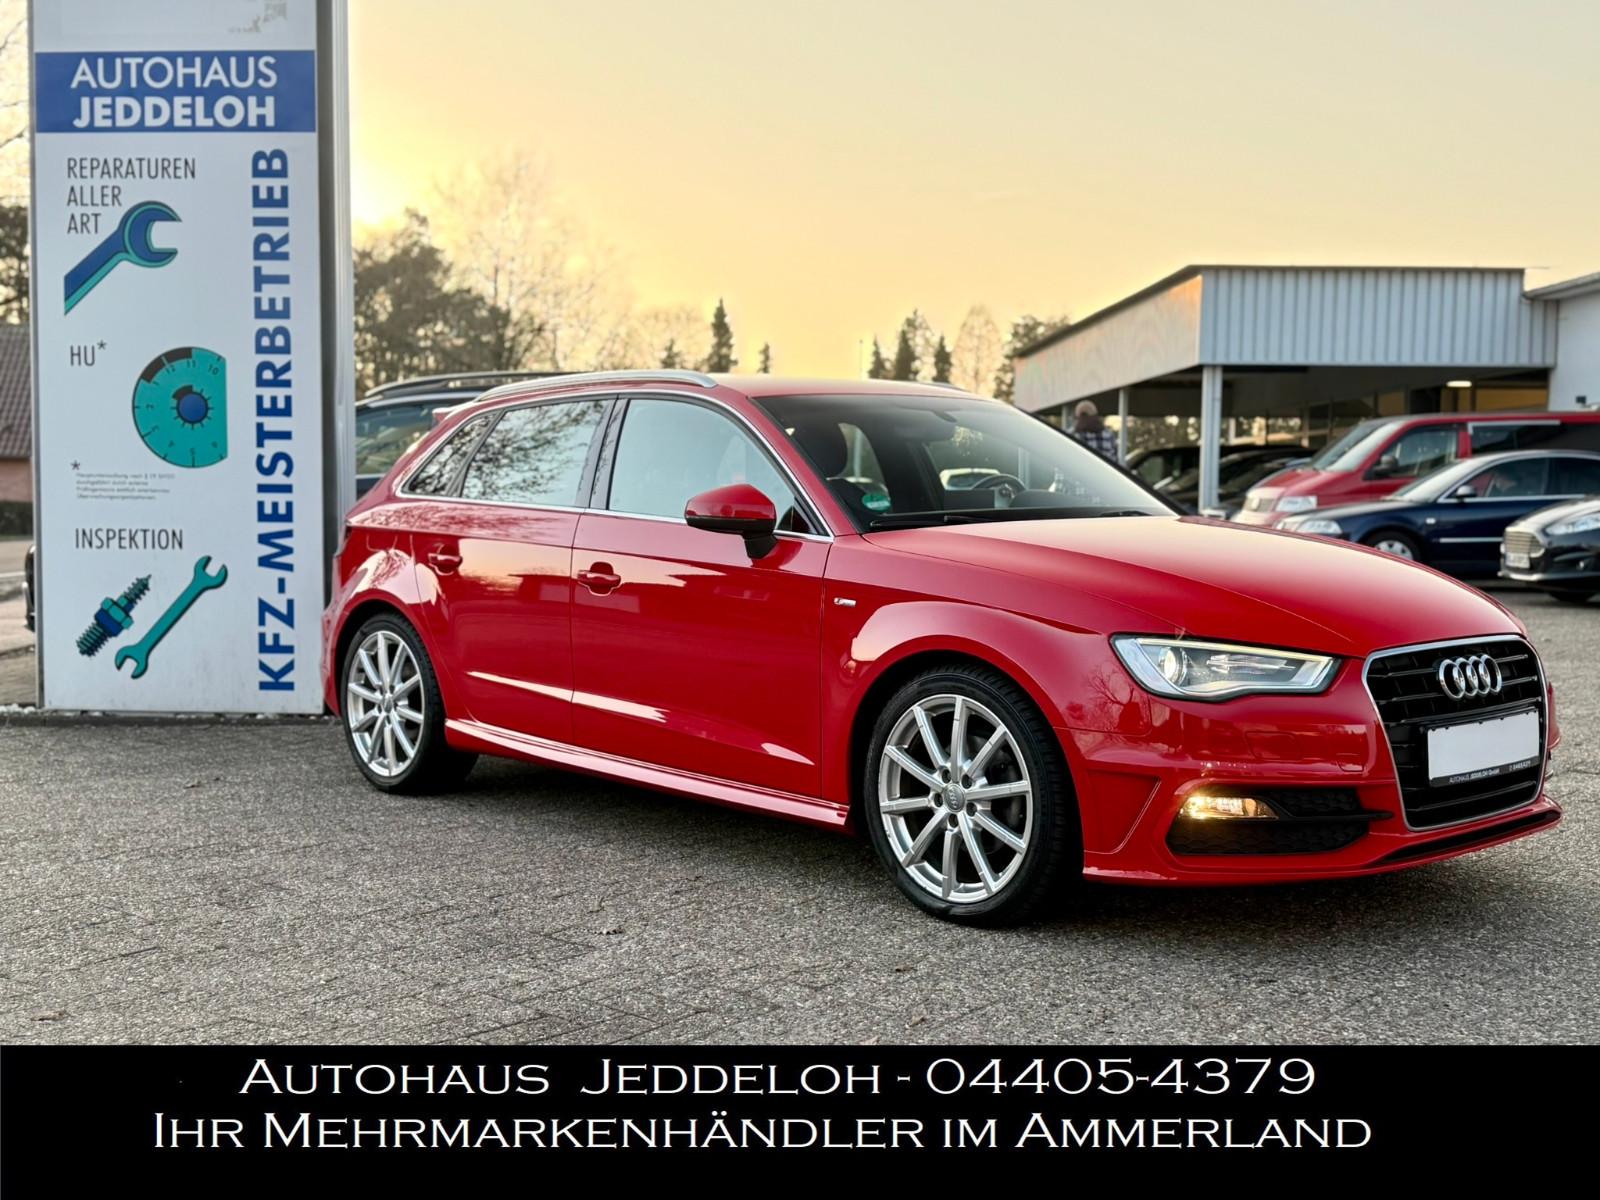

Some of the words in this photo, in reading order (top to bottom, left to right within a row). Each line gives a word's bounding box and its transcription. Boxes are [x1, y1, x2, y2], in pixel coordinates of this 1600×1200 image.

[70, 56, 277, 89] AUTOHAUS
[73, 95, 275, 128] JEDDELOH
[67, 157, 196, 180] REPARATUREN
[67, 185, 122, 207] ALLER
[67, 213, 101, 234] ART
[252, 148, 295, 691] KFZ-MEISTERBETRIEB
[75, 527, 183, 550] INSPEKTION
